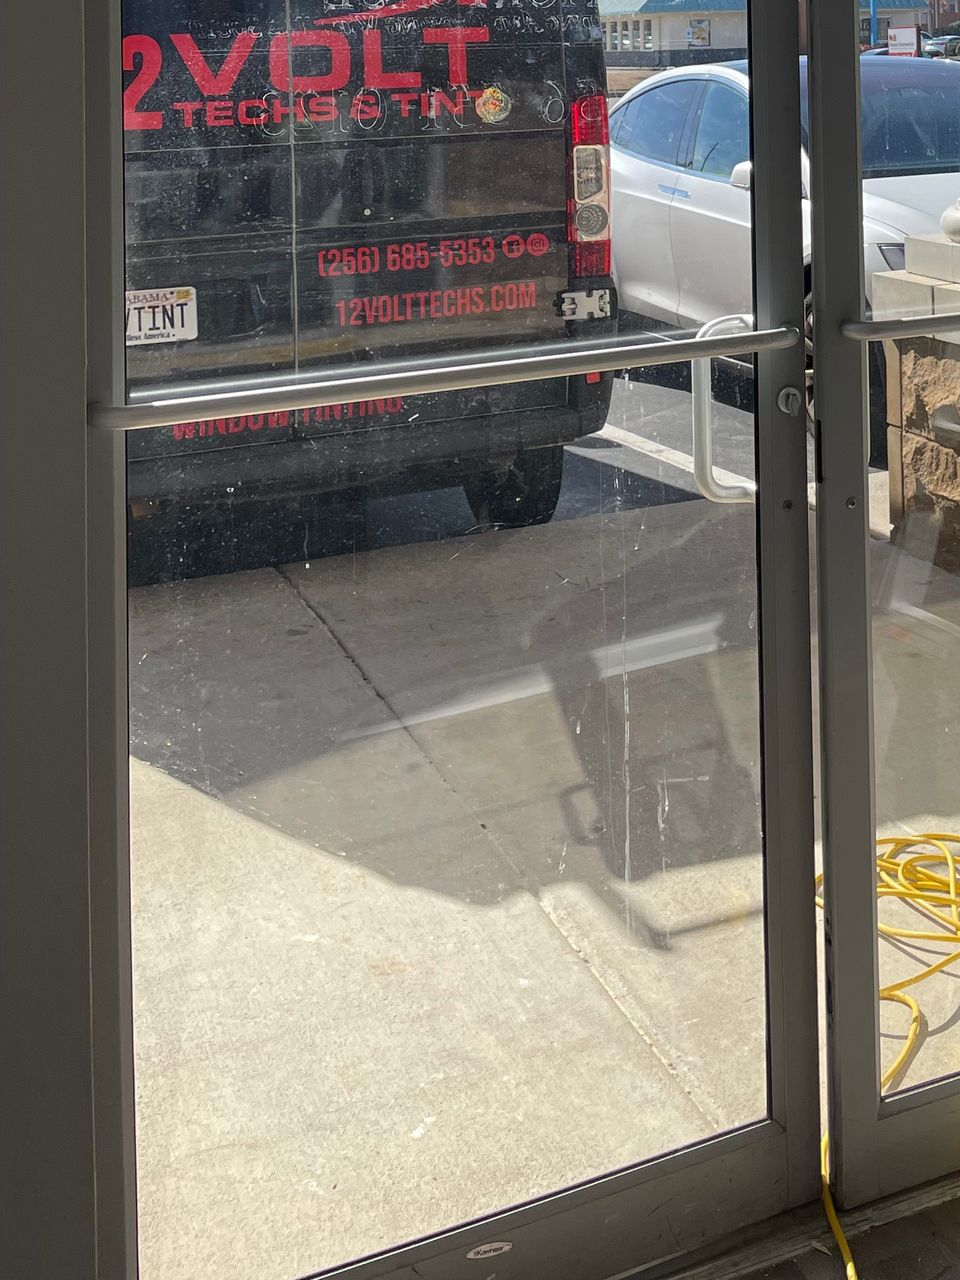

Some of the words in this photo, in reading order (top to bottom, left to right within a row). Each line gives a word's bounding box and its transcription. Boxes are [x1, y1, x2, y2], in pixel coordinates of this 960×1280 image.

[172, 96, 339, 128] TECHS
[351, 94, 382, 120] &
[318, 246, 380, 278] (256)
[386, 236, 497, 272] 685-5353
[335, 281, 537, 328] 12VOLTTECHS.COM
